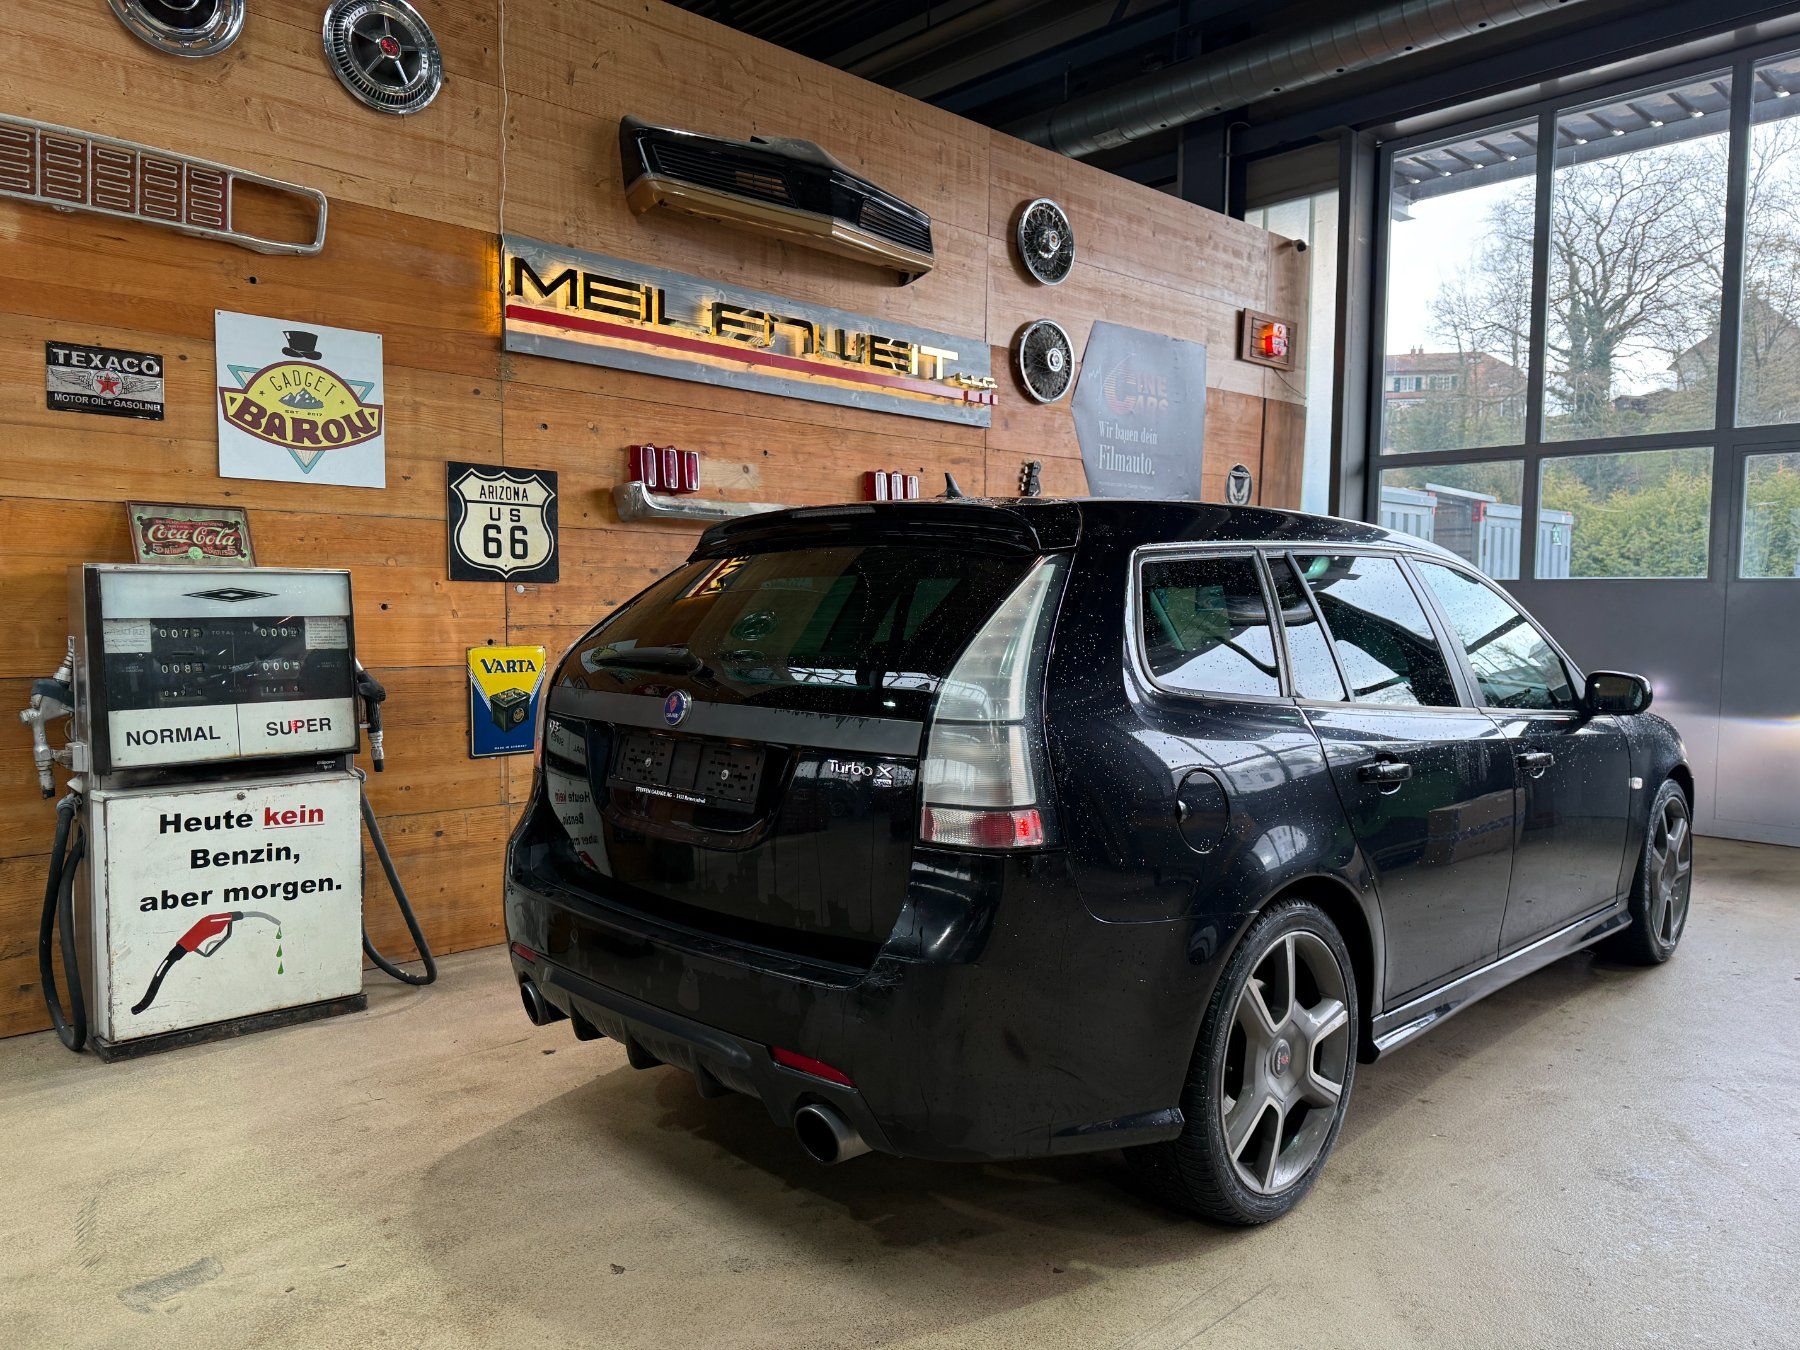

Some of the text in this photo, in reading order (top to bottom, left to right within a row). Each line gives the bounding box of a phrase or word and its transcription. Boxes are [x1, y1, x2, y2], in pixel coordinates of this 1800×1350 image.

[50, 347, 160, 375] TEXACO
[269, 370, 337, 397] GADGET
[55, 393, 162, 412] MOTOR OIL GASOLINE
[230, 395, 377, 445] BARON
[1098, 420, 1158, 445] Wir bauen dein
[1098, 444, 1156, 476] Filmauto.
[479, 484, 529, 502] ARIZONA
[483, 523, 528, 560] 66
[480, 658, 537, 674] VARTA
[126, 725, 221, 747] NORMAL
[265, 716, 332, 737] SUPER
[827, 759, 894, 779] Turbo X
[159, 805, 324, 834] Heute kein
[190, 843, 300, 869] Benzin,
[139, 876, 342, 912] aber morgen.
